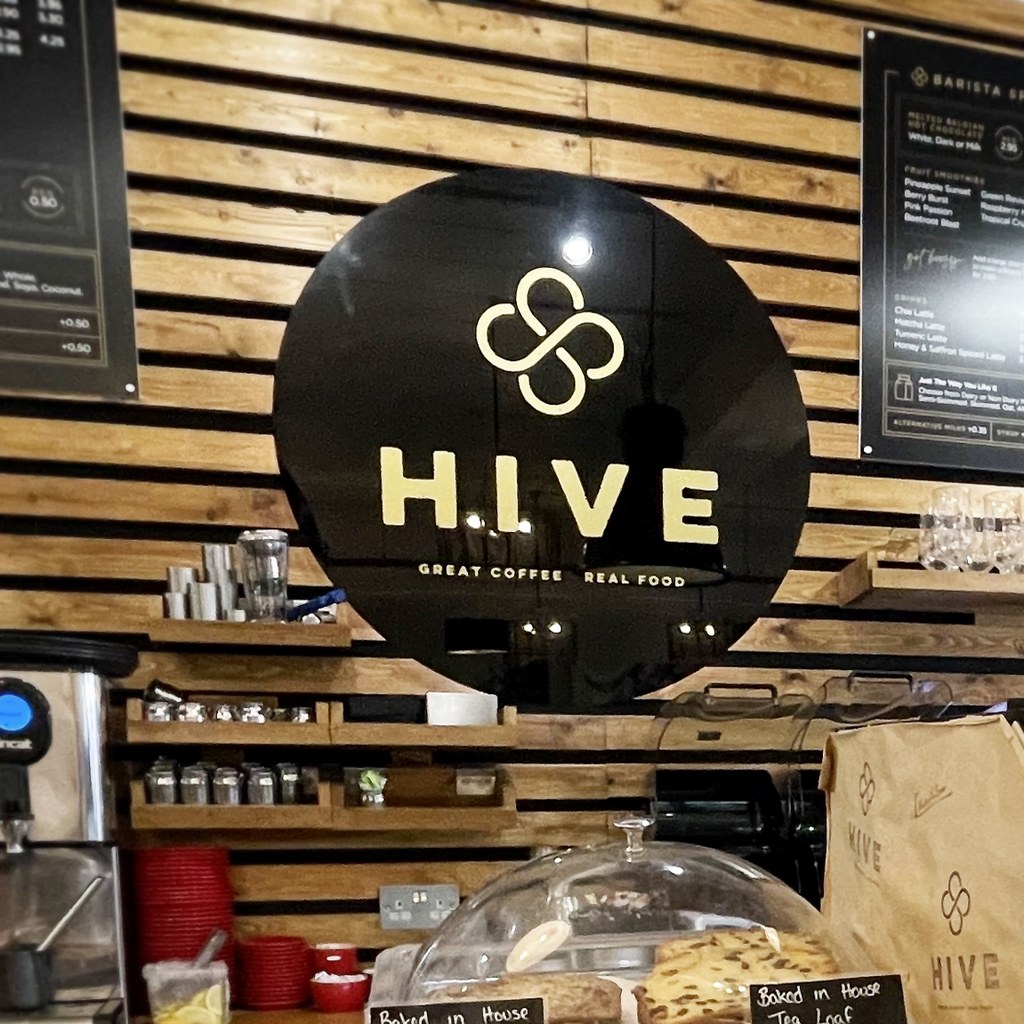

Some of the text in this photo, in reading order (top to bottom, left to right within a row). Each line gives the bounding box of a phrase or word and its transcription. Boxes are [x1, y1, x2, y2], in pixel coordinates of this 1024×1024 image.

[933, 73, 1002, 98] BARISTA
[930, 124, 984, 142] CHOCOLATE
[935, 137, 954, 150] Dark
[966, 142, 982, 152] Milk
[904, 165, 985, 185] FRUIT SMOOTHIES
[904, 190, 927, 203] Berry
[944, 184, 972, 197] Sunset
[28, 194, 59, 208] 0.50
[904, 201, 954, 217] Pink Passion
[981, 213, 1012, 226] Tropical
[914, 308, 935, 320] Latte
[59, 317, 91, 330] +0.50
[894, 318, 946, 332] Matcha Latte
[927, 332, 948, 344] Latte
[61, 342, 92, 355] +0.50
[894, 340, 919, 353] Honey
[920, 343, 928, 353] &
[929, 345, 957, 357] Saffron
[986, 351, 1007, 364] Latte
[918, 376, 933, 387] Just
[934, 377, 947, 387] The
[947, 379, 963, 391] Way
[977, 383, 992, 392] Like
[918, 386, 944, 398] Choose
[944, 388, 961, 399] from
[893, 418, 943, 432] ALTERNATIVE
[379, 445, 720, 545] HIVE
[418, 562, 686, 588] GREAT COFFEE REAL FOOD
[848, 822, 882, 873] HIVE
[931, 953, 1000, 990] HIVE
[757, 982, 881, 1007] Baked in House
[482, 1006, 529, 1024] House
